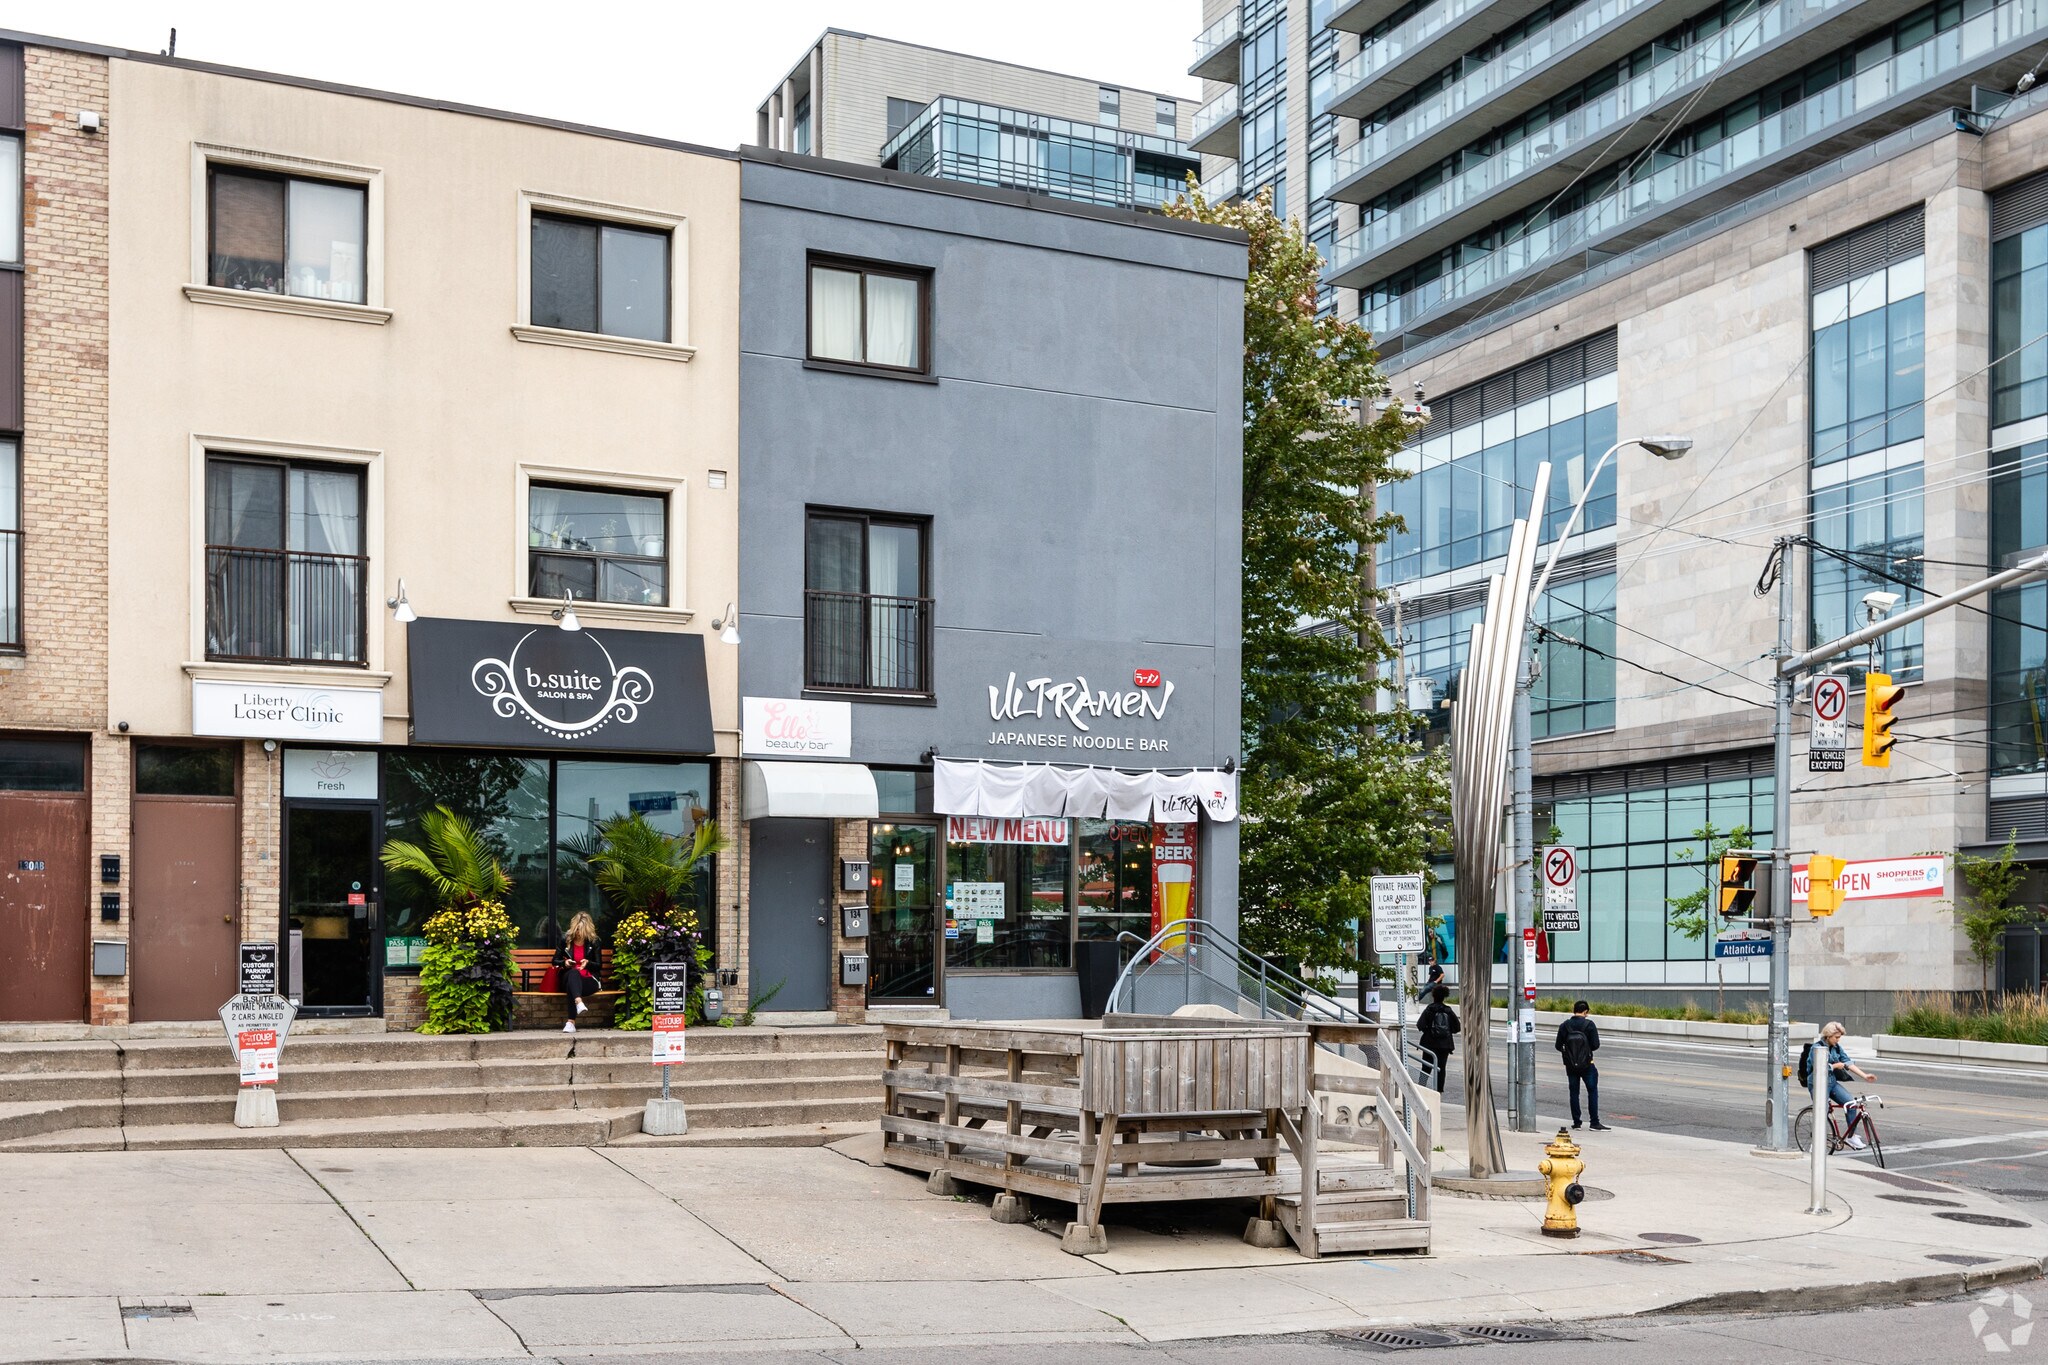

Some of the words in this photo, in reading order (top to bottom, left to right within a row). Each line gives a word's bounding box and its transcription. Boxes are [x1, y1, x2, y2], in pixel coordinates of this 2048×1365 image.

[525, 667, 602, 690] b.suite
[1135, 673, 1159, 684] ラーメン
[537, 690, 567, 699] SALON
[243, 693, 292, 710] Liberty
[234, 704, 285, 720] Laser
[291, 706, 343, 723] Clinic
[763, 702, 806, 739] Elle
[765, 739, 806, 750] beauty
[988, 732, 1067, 747] JAPANESE
[1072, 735, 1134, 750] NOODLE
[1139, 738, 1169, 751] BAR
[1811, 761, 1843, 769] EXCEPTED
[317, 781, 345, 790] Fresh
[949, 817, 999, 840] NEW
[1003, 818, 1066, 843] MENU
[1109, 825, 1149, 843] OPEN
[1155, 846, 1193, 860] BEER
[1877, 869, 1925, 878] SHOPPERS
[1374, 882, 1395, 891] PRIVATE
[1397, 882, 1419, 890] PARKING
[1555, 912, 1579, 920] VEHICLES
[1723, 943, 1756, 955] Atlantic
[1757, 945, 1766, 953] Av
[849, 964, 860, 972] 134
[232, 1002, 256, 1011] PRIVATE
[258, 1002, 285, 1011] PARKING
